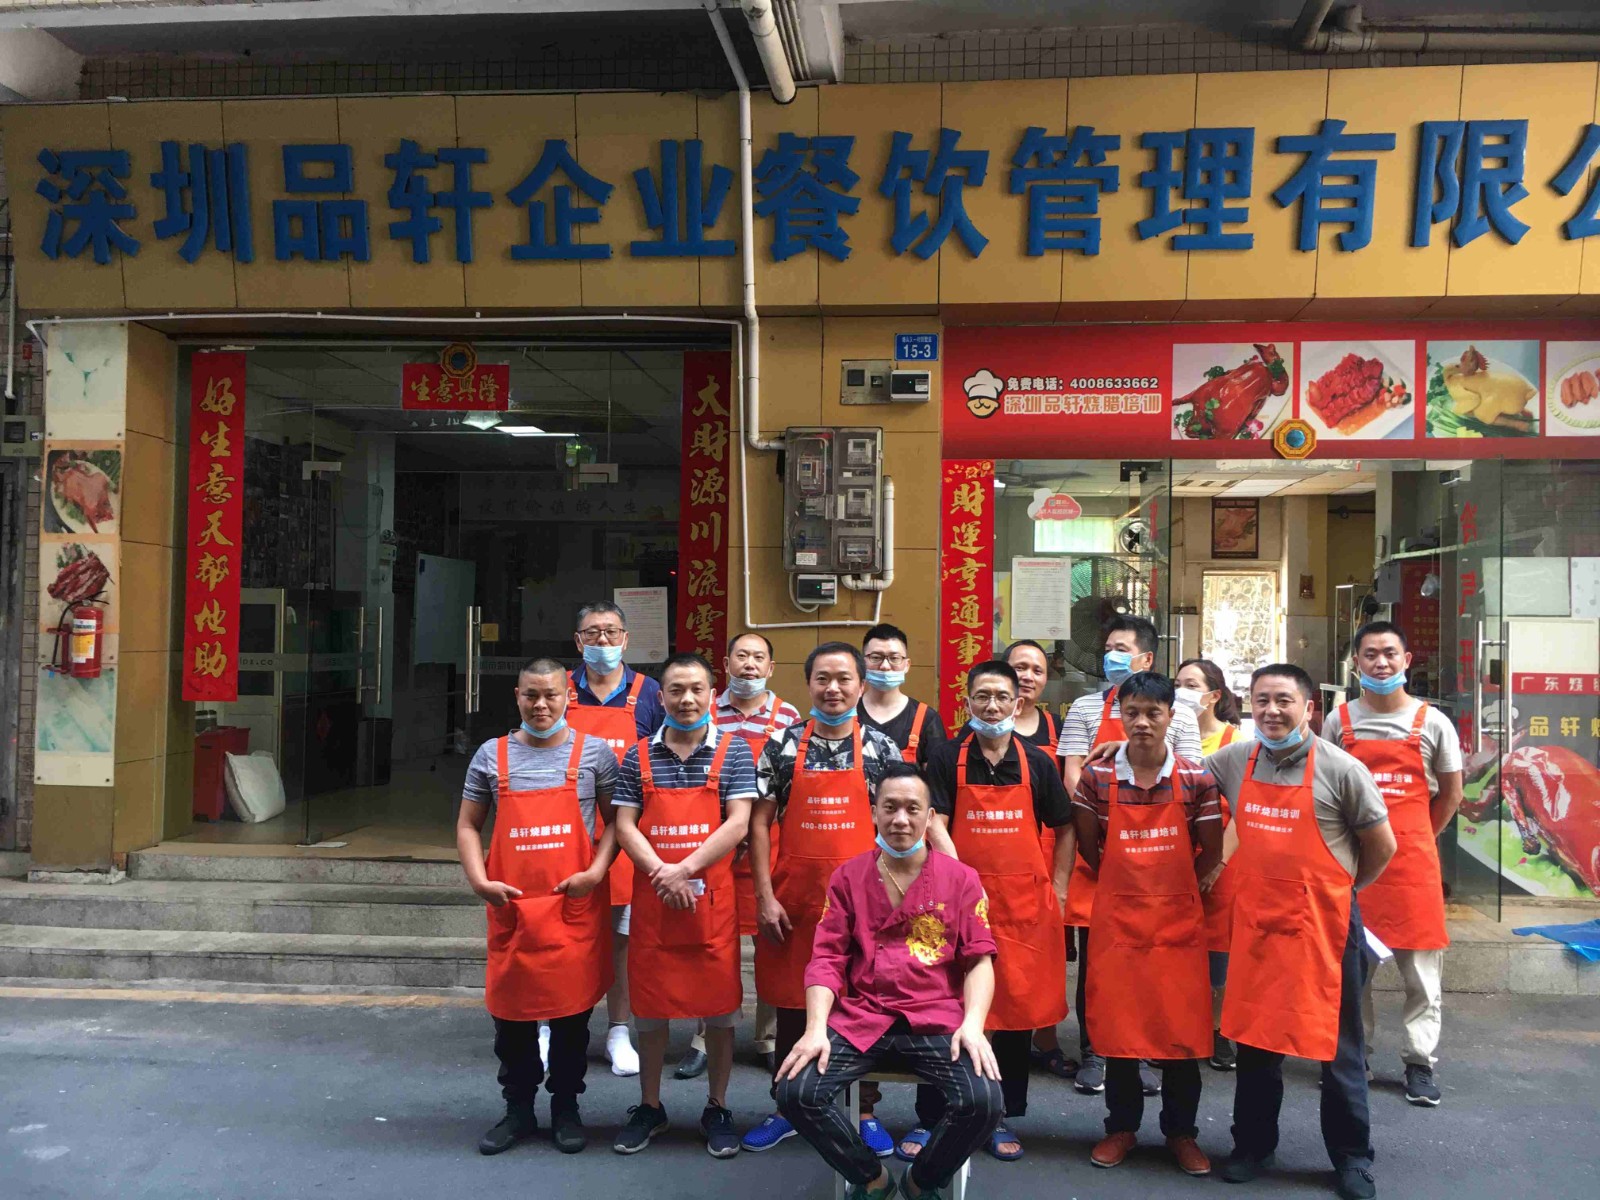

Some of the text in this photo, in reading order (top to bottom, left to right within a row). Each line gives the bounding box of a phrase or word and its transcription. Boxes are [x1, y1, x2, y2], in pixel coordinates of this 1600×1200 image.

[904, 344, 931, 358] 15-3
[1070, 377, 1159, 389] 4008633662
[1004, 393, 1162, 415] 深圳品轩烧腊培训
[192, 375, 236, 678] 好生意天帮地助
[806, 796, 850, 804] 品轩烧腊培训
[966, 809, 1023, 820] 品轩烧腊培训
[1244, 802, 1301, 820] 品轩烧腊培训
[509, 823, 572, 838] 品轩烧腊培训
[650, 823, 710, 835] 品轩烧腊培训
[800, 821, 856, 830] 400-8633-662
[1119, 826, 1179, 840] 品轩烧腊培训
